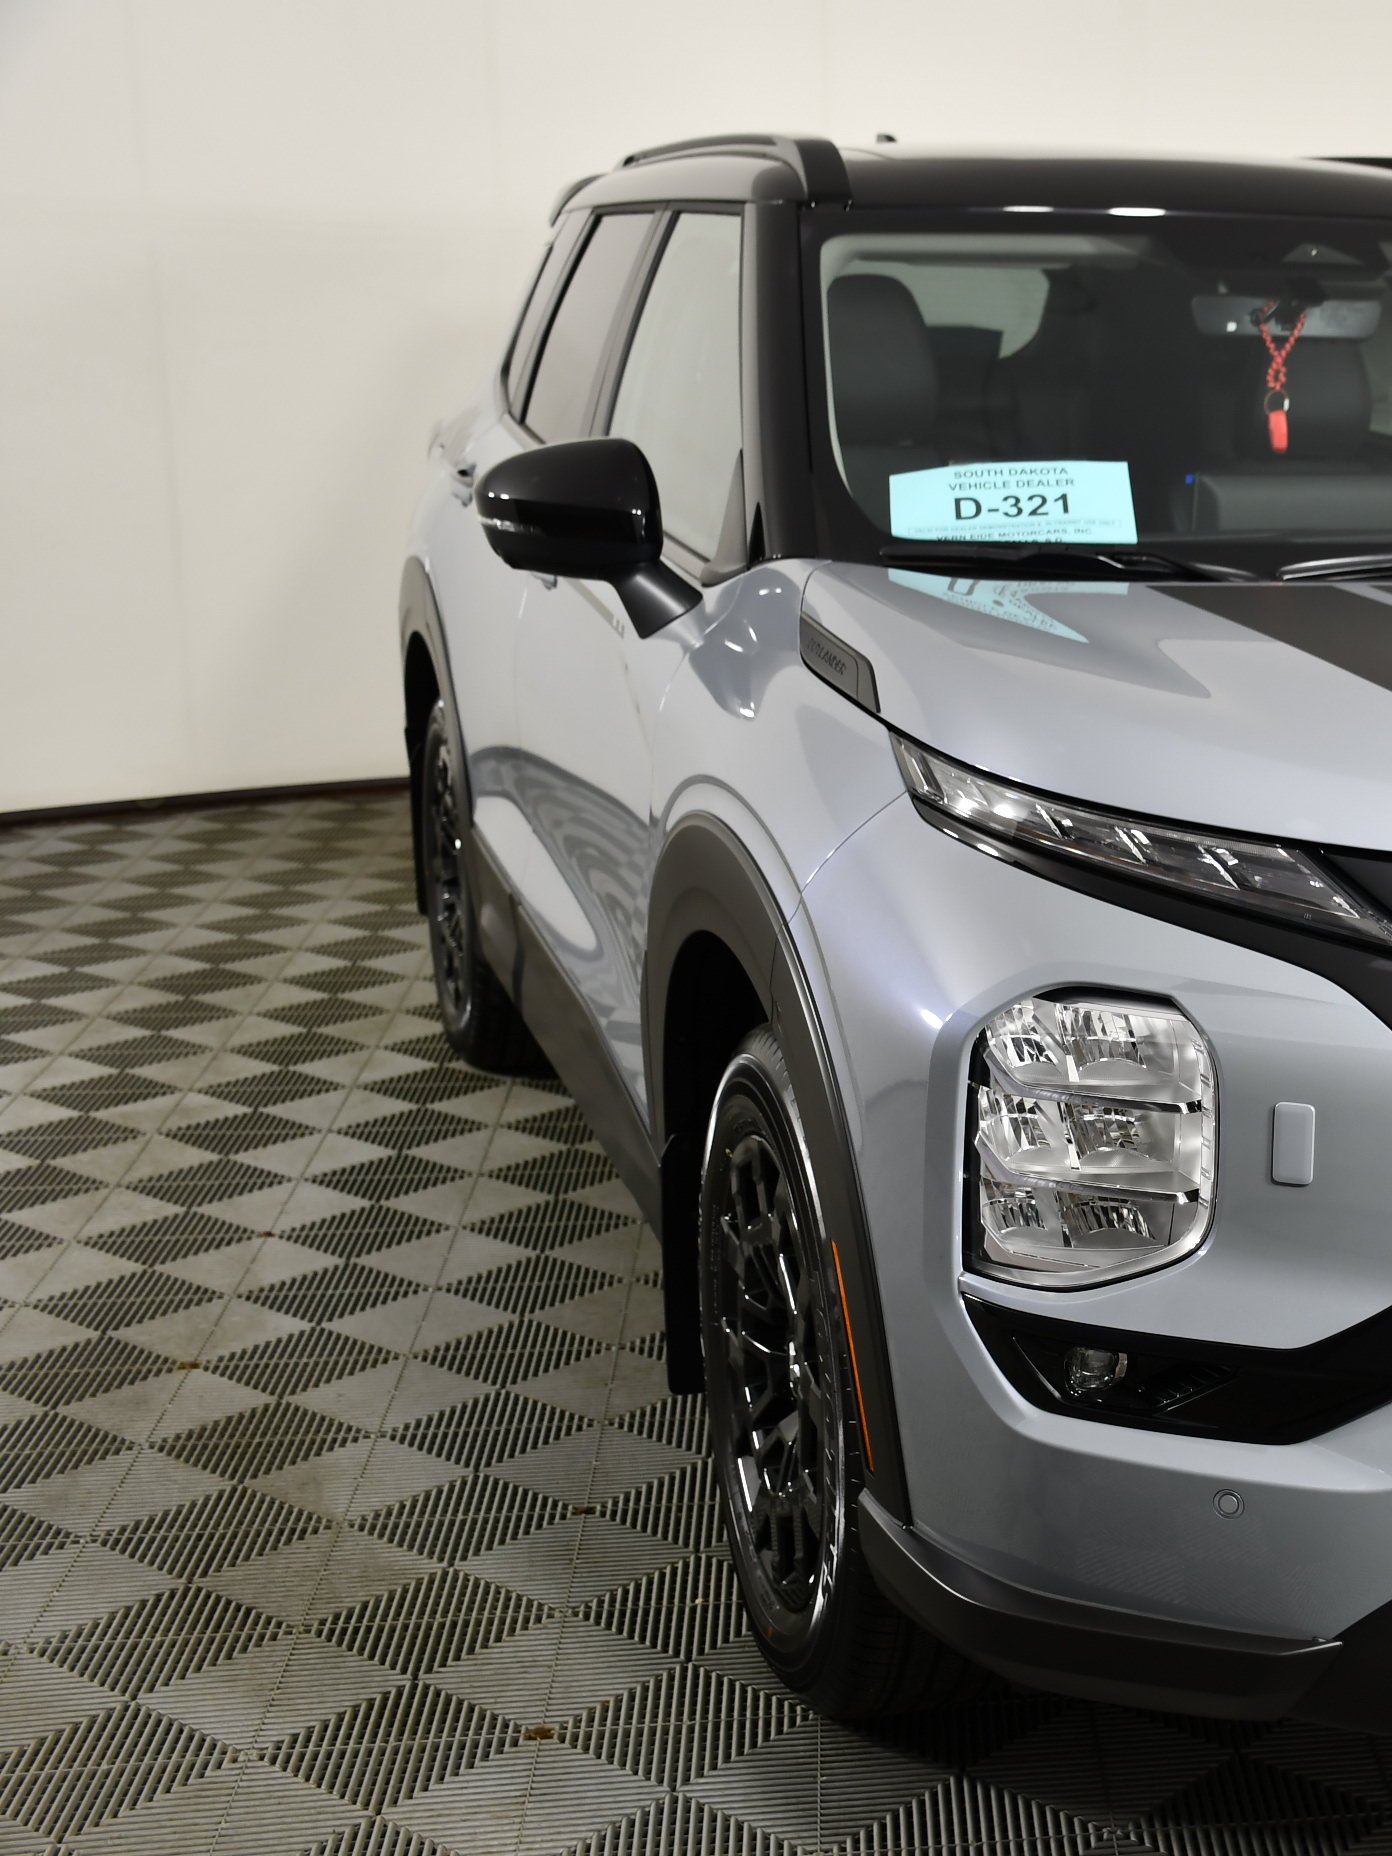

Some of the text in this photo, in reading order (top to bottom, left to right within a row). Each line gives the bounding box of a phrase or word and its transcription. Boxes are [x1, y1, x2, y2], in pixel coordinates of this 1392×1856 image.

[953, 467, 1069, 479] SOUTH DAKOTA
[948, 478, 1075, 491] VEHICLE DEALER
[954, 493, 1070, 520] D-321
